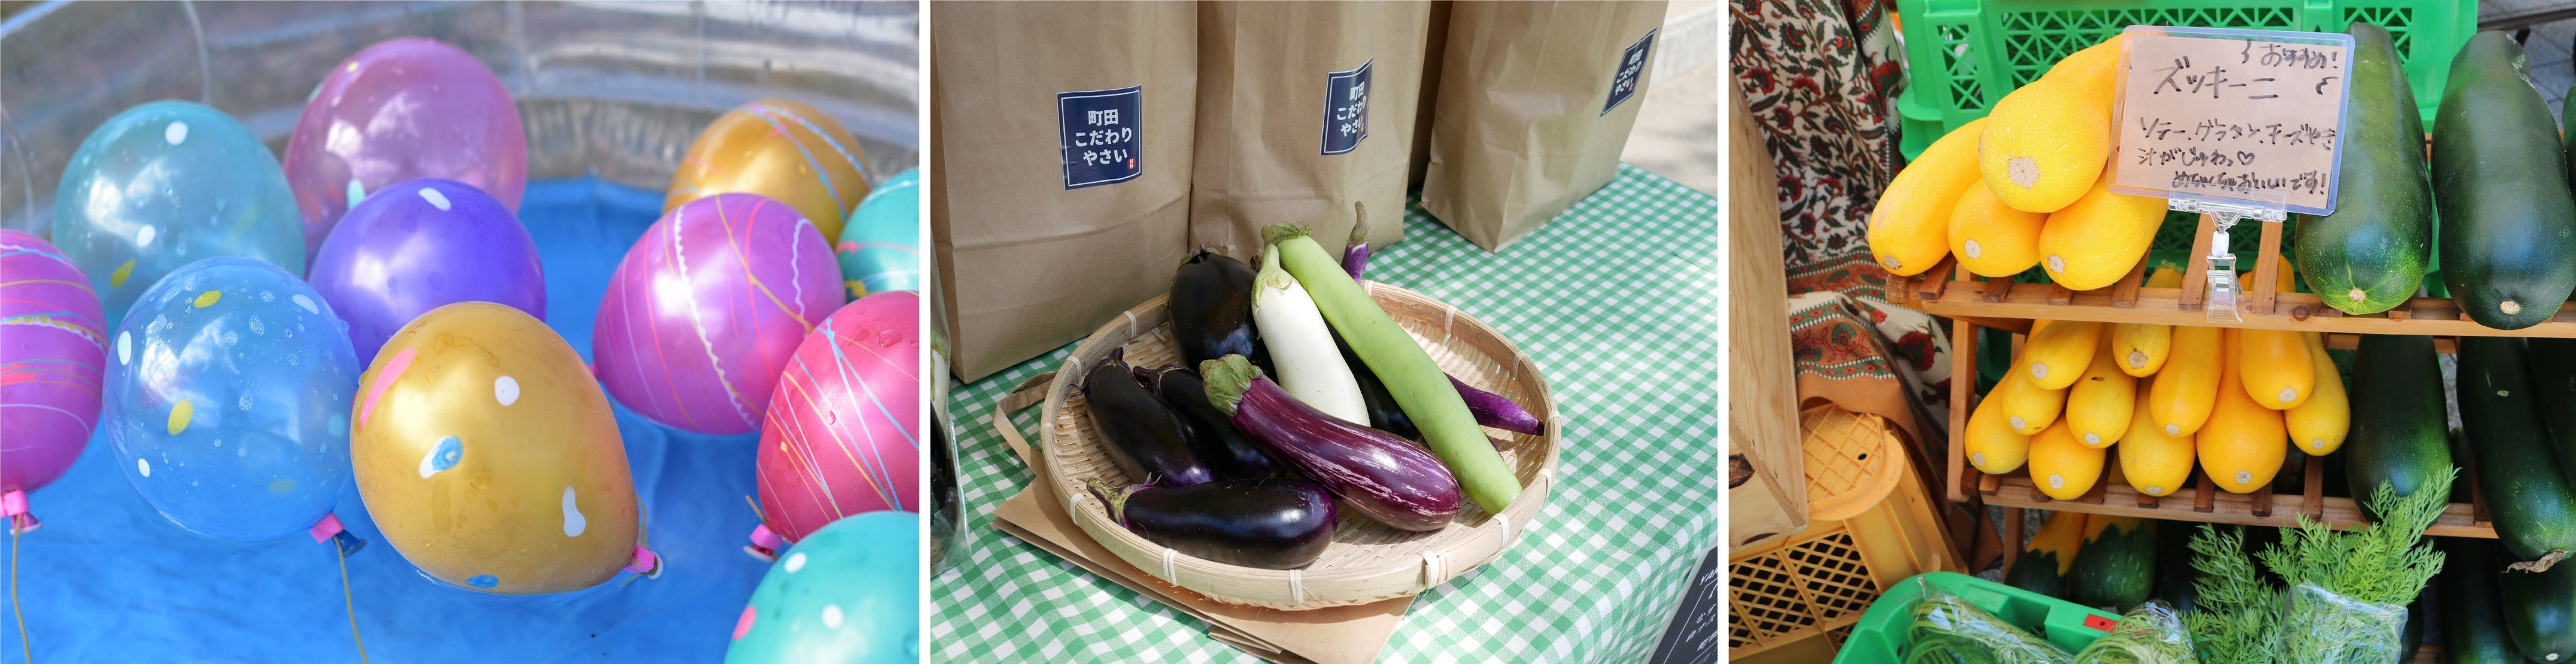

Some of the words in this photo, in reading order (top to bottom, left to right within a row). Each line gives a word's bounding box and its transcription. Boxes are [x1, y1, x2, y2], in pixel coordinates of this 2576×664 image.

[2153, 55, 2279, 98] ズッキーニ
[1349, 81, 1365, 101] 町田
[1088, 109, 1119, 126] 町田
[1337, 95, 1367, 121] こだわり
[1340, 115, 1363, 137] やさい
[1075, 127, 1132, 147] こだわり
[1083, 149, 1128, 166] やさい
